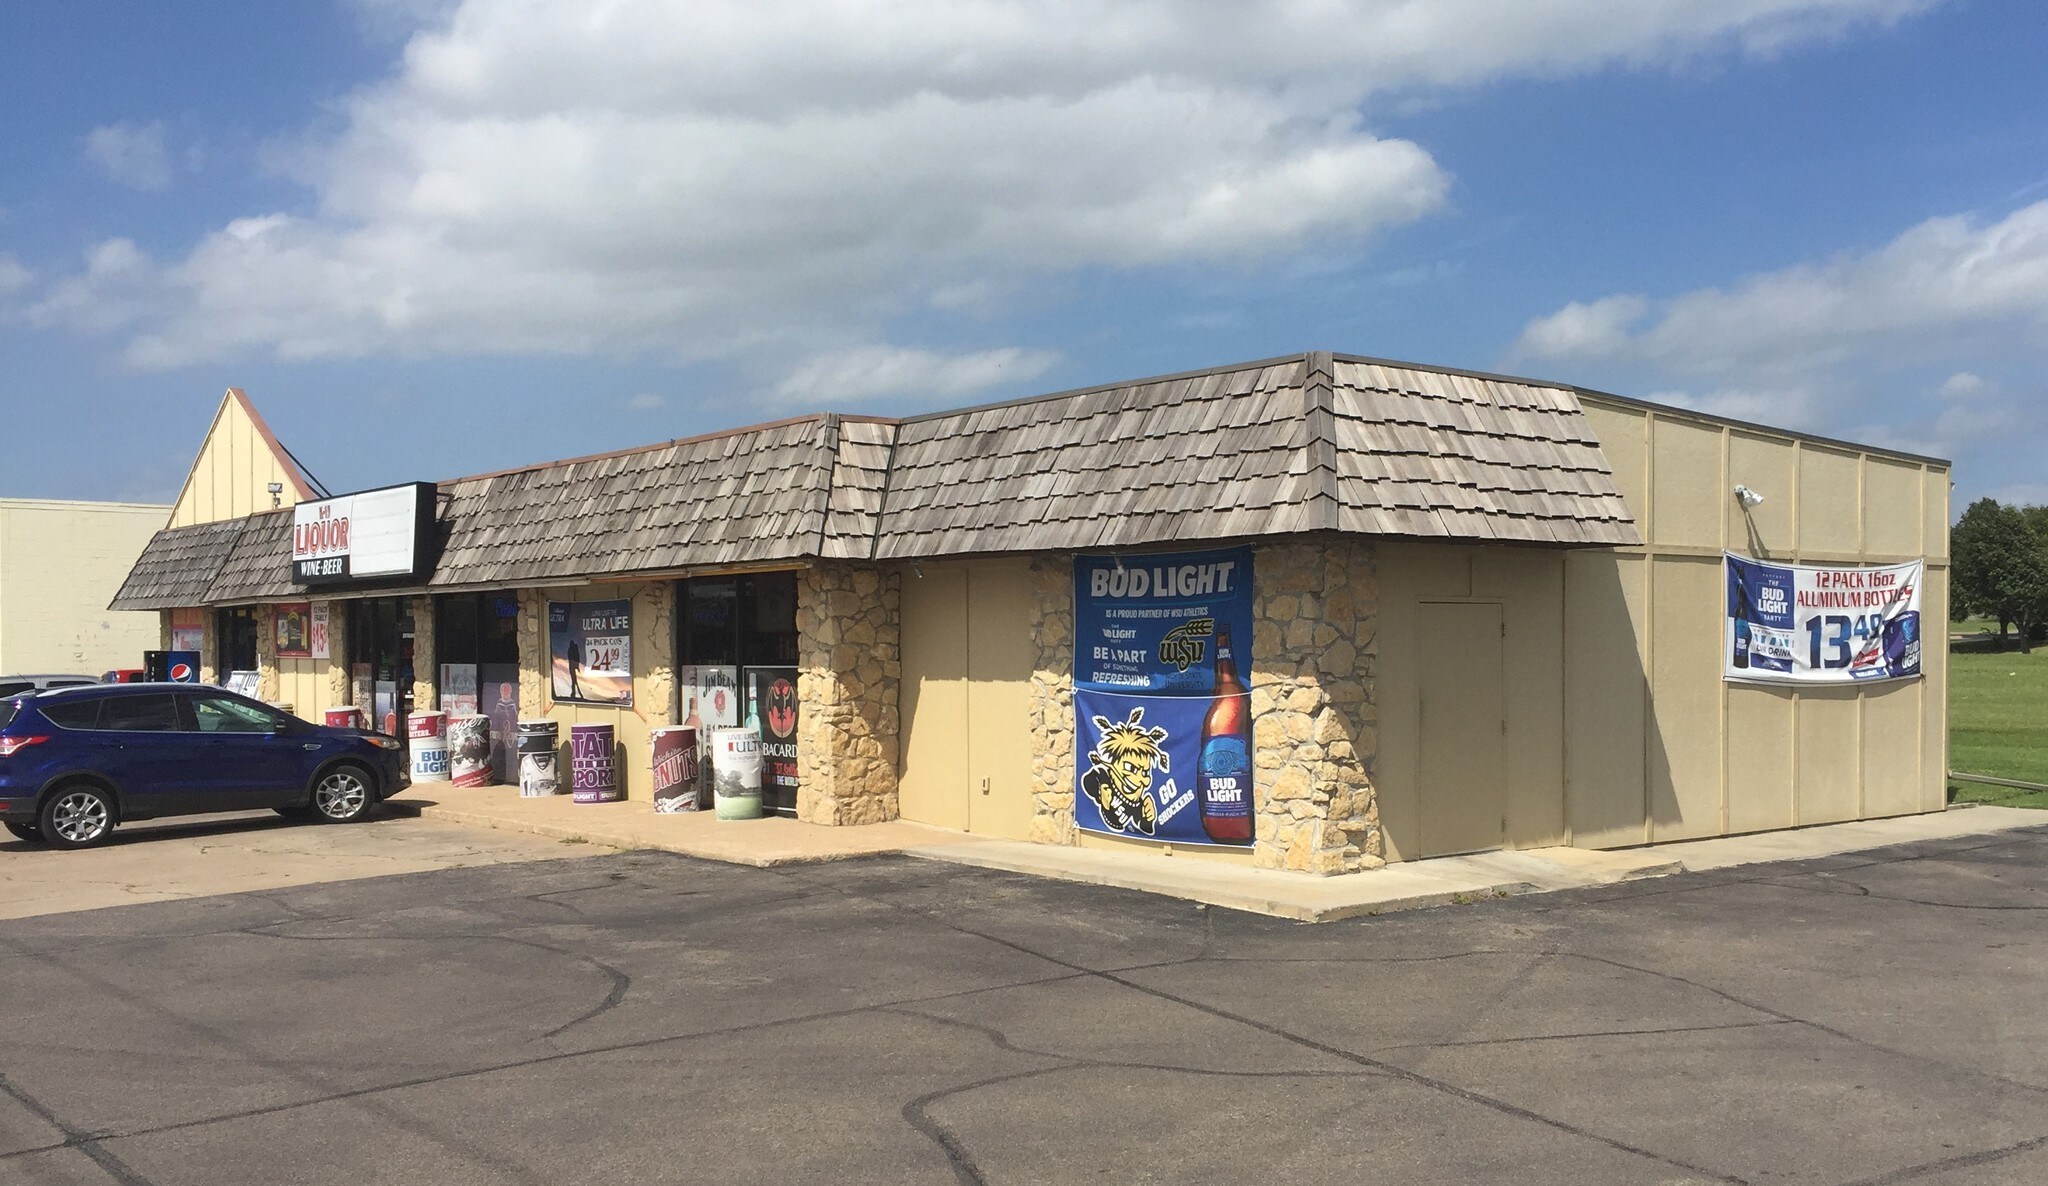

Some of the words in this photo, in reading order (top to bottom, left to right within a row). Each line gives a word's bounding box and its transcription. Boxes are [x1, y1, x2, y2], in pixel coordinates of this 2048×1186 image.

[295, 517, 349, 557] LIQUOR
[1091, 568, 1150, 597] BUD
[1154, 561, 1235, 597] LIGHT
[1816, 572, 1830, 588] 12
[1832, 572, 1864, 588] PACK
[1761, 587, 1784, 601] BUD
[1797, 590, 1861, 607] ALUMINUM
[1105, 610, 1112, 618] IS
[1112, 610, 1117, 618] A
[1117, 609, 1137, 618] PROUD
[1138, 609, 1162, 618] PARTNER
[1163, 609, 1170, 618] OF
[1171, 609, 1183, 618] WSU
[1183, 606, 1208, 617] ATHLETICS
[1757, 599, 1788, 614] LIGHT
[582, 618, 607, 631] ULTRA
[610, 615, 629, 630] LIFE
[1112, 629, 1137, 639] LIGHT
[1806, 615, 1852, 669] 13
[590, 648, 611, 671] 24
[1093, 646, 1109, 660] BE
[1117, 649, 1147, 663] PART
[1159, 635, 1206, 673] WSU
[1092, 671, 1150, 687] REFRESHING
[421, 750, 448, 762] BUD
[763, 742, 798, 758] BACARD
[416, 762, 448, 773] LIGH
[1158, 777, 1178, 805] GO
[1209, 777, 1237, 790] BUD
[1207, 789, 1242, 802] LIGHT
[1110, 796, 1130, 824] WSU
[1157, 789, 1195, 826] SHOCKERS
